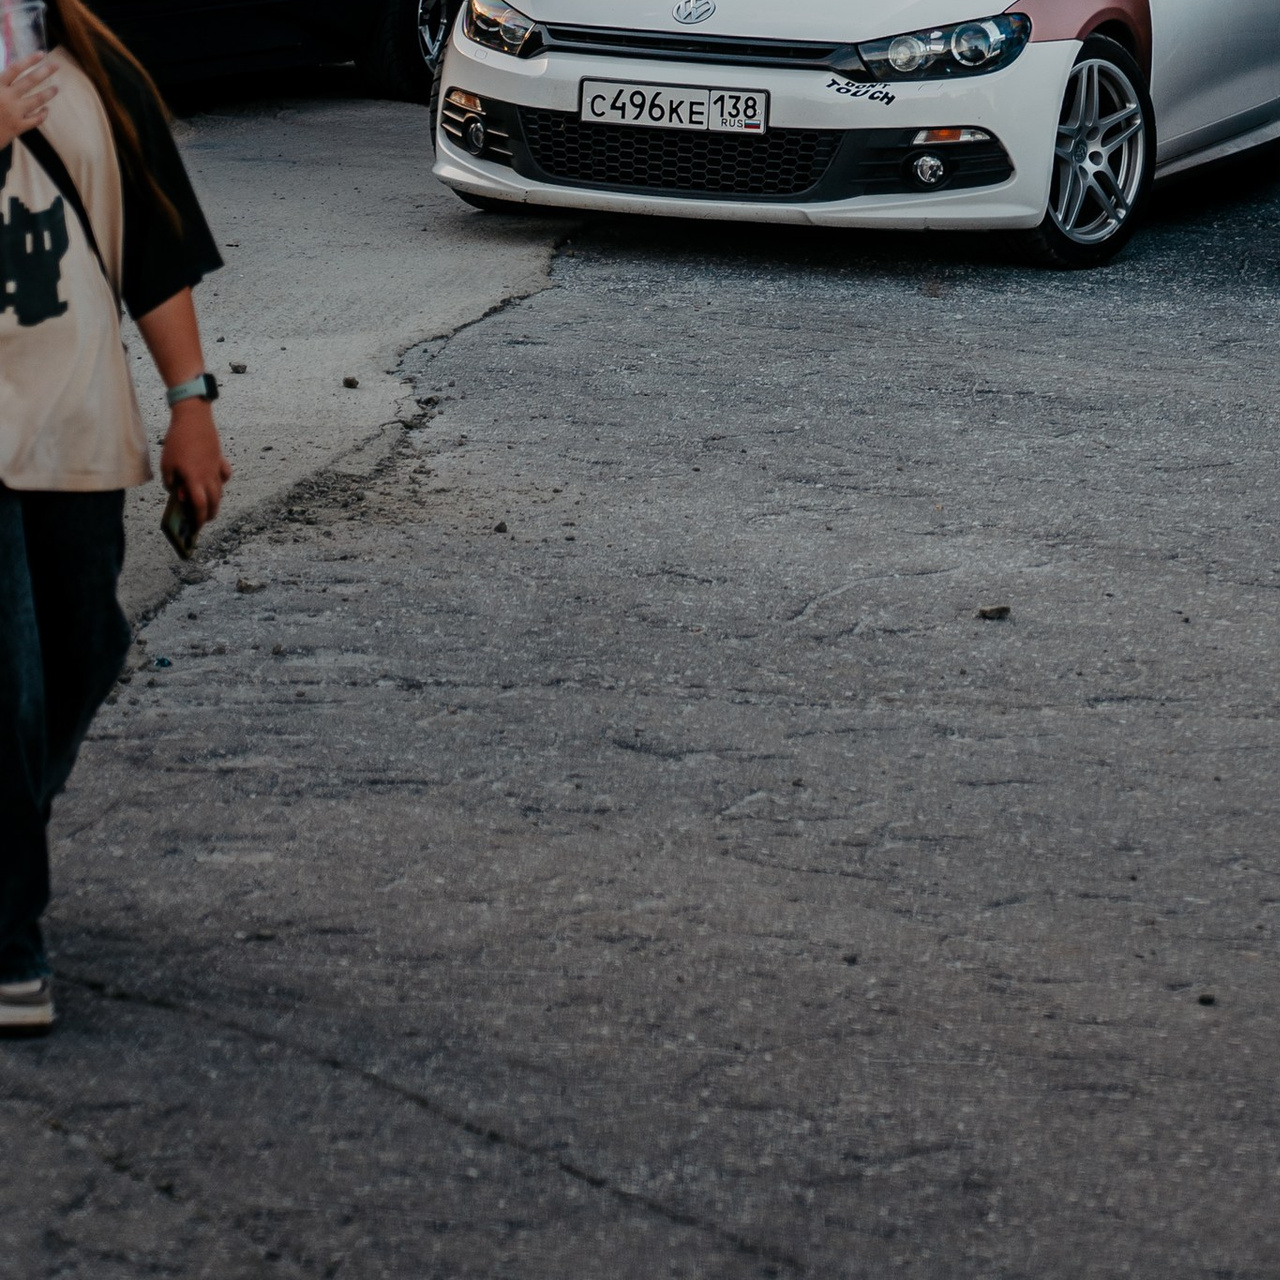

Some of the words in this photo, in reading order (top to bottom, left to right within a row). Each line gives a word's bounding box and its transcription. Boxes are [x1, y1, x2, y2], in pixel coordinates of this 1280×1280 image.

[826, 78, 896, 106] TOUCH
[844, 81, 891, 90] DON'T
[590, 89, 705, 125] С496КЕ
[713, 94, 758, 119] 138
[721, 118, 744, 128] RUS
